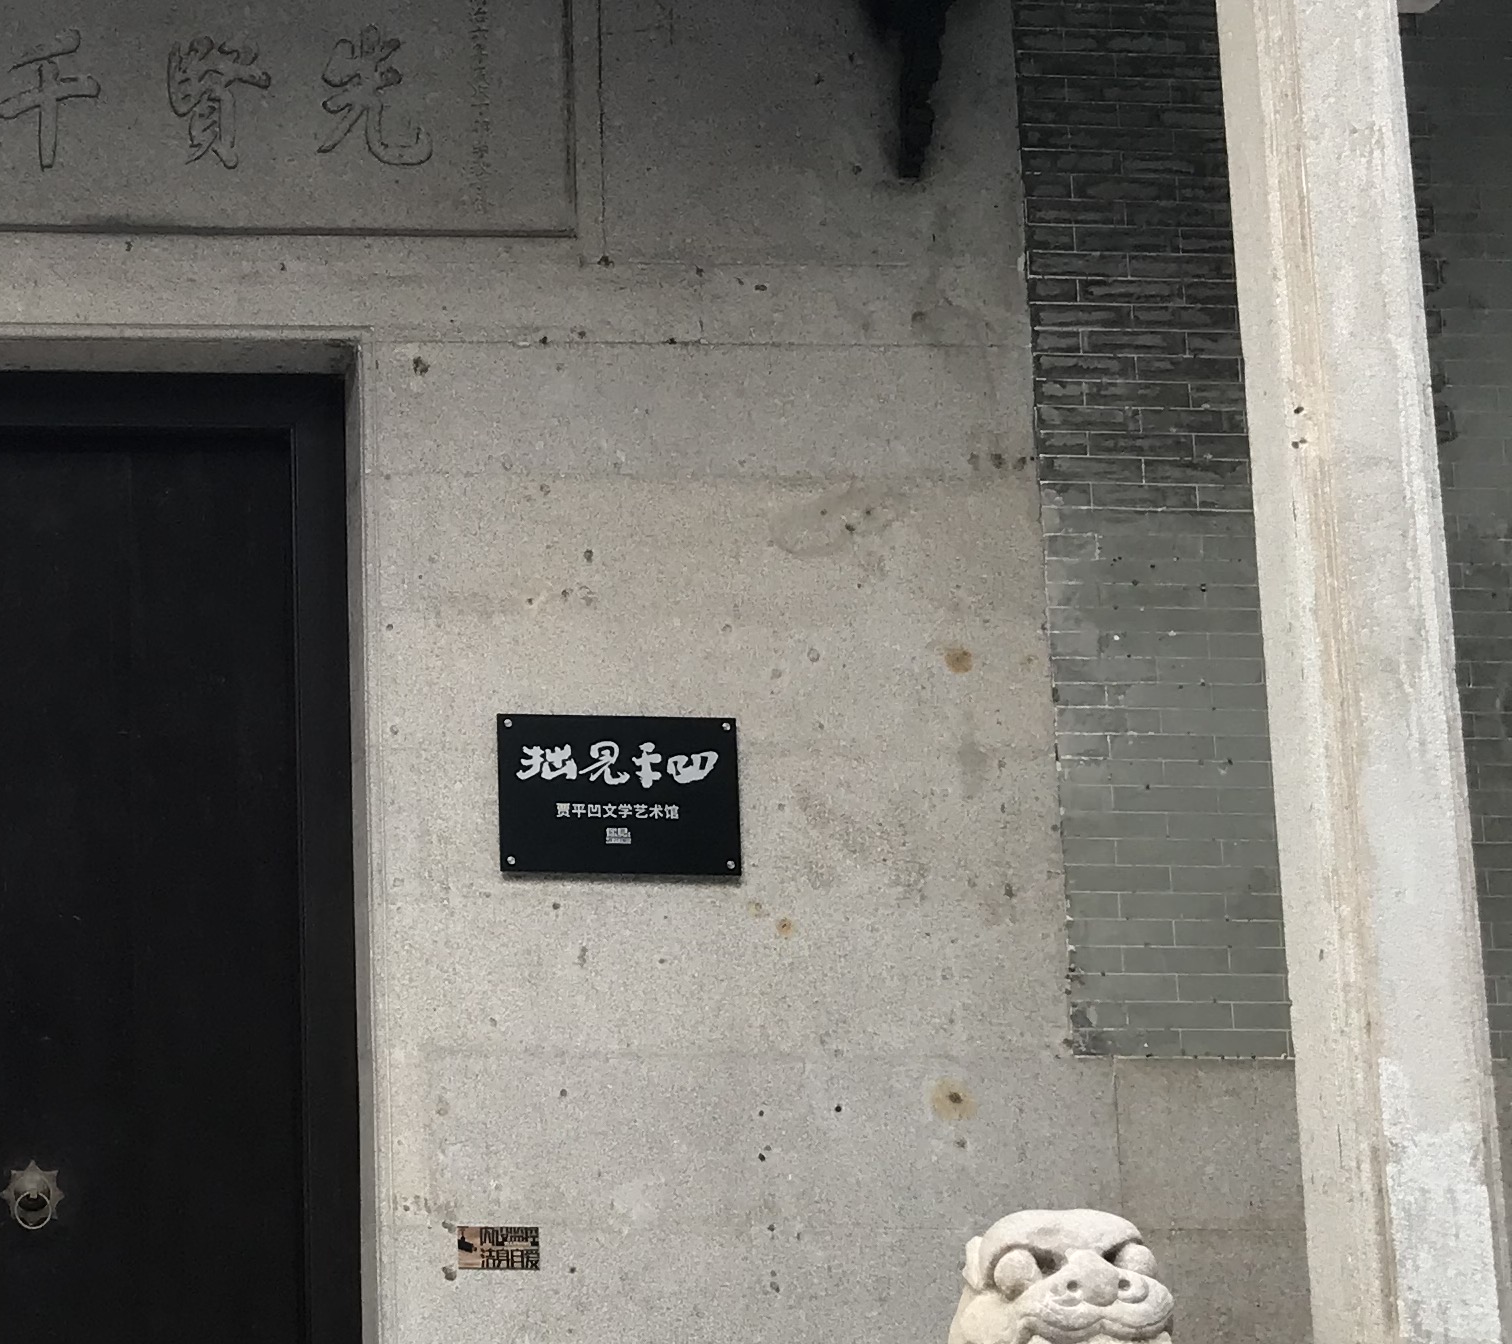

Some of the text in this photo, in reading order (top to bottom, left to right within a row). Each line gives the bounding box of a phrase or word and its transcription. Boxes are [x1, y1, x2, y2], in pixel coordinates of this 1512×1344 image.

[555, 802, 680, 820] 贾平凹文学艺术馆
